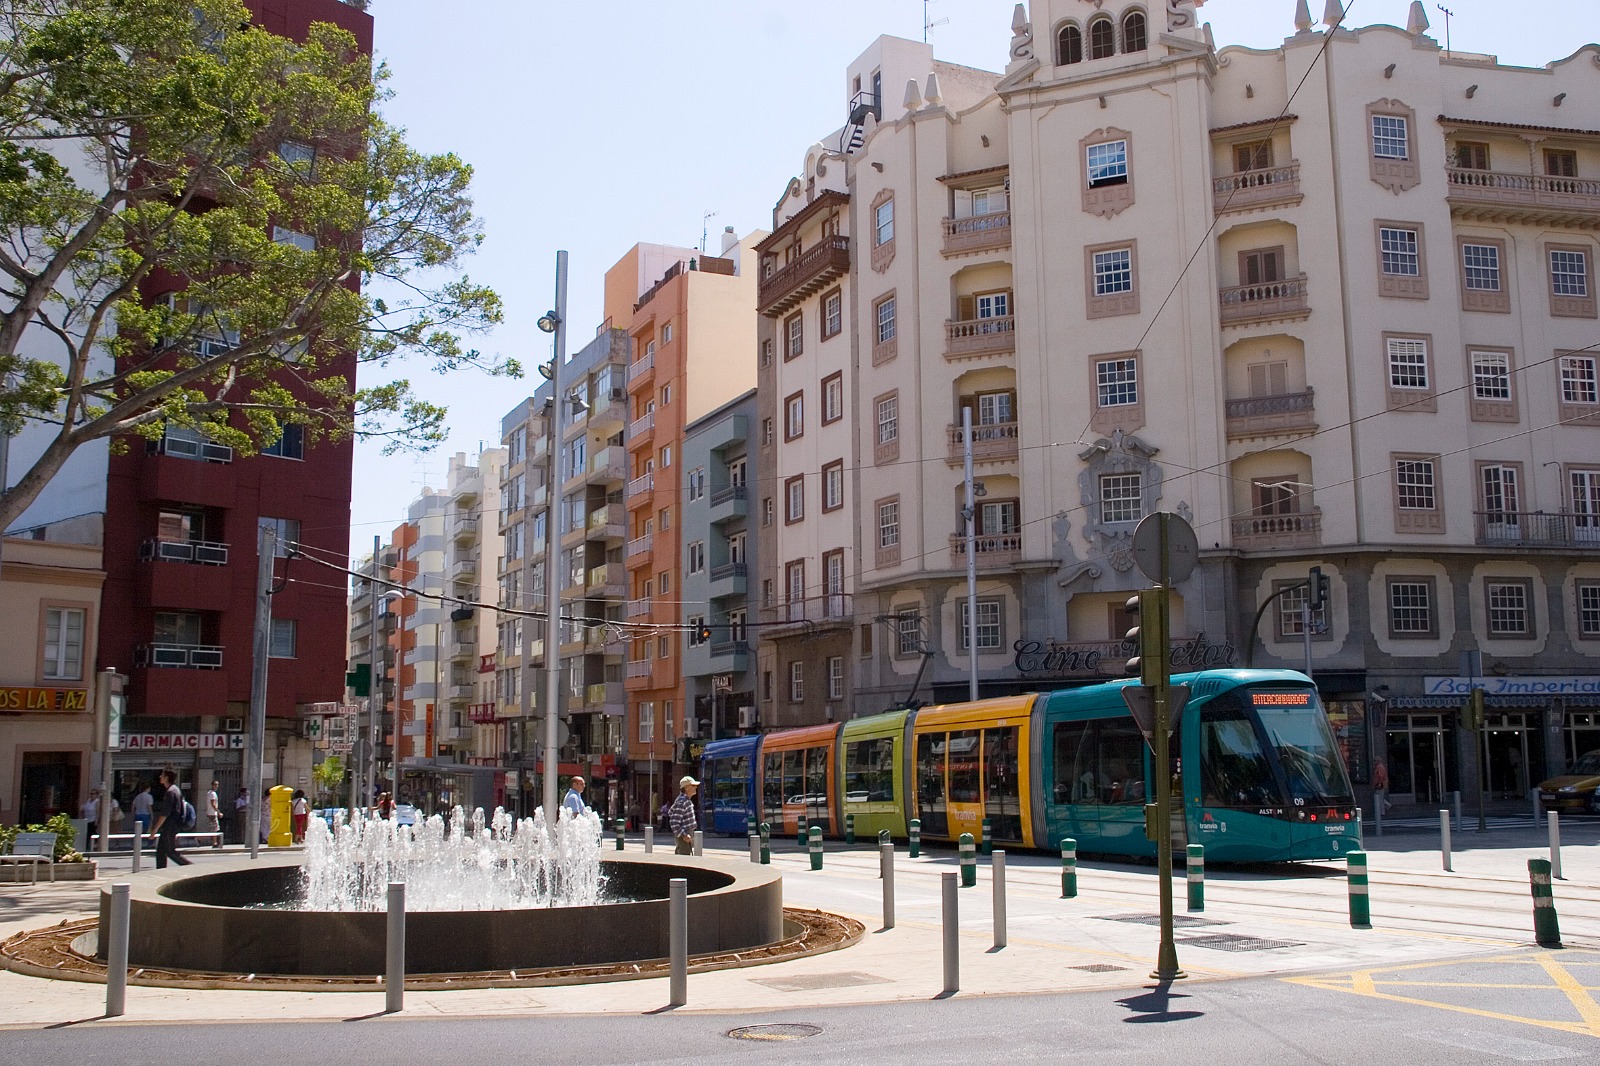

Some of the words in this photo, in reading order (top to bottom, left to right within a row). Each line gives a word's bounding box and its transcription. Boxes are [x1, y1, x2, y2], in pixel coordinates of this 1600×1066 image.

[1013, 639, 1101, 672] Cine
[1431, 678, 1485, 693] Bar
[27, 690, 48, 708] LA
